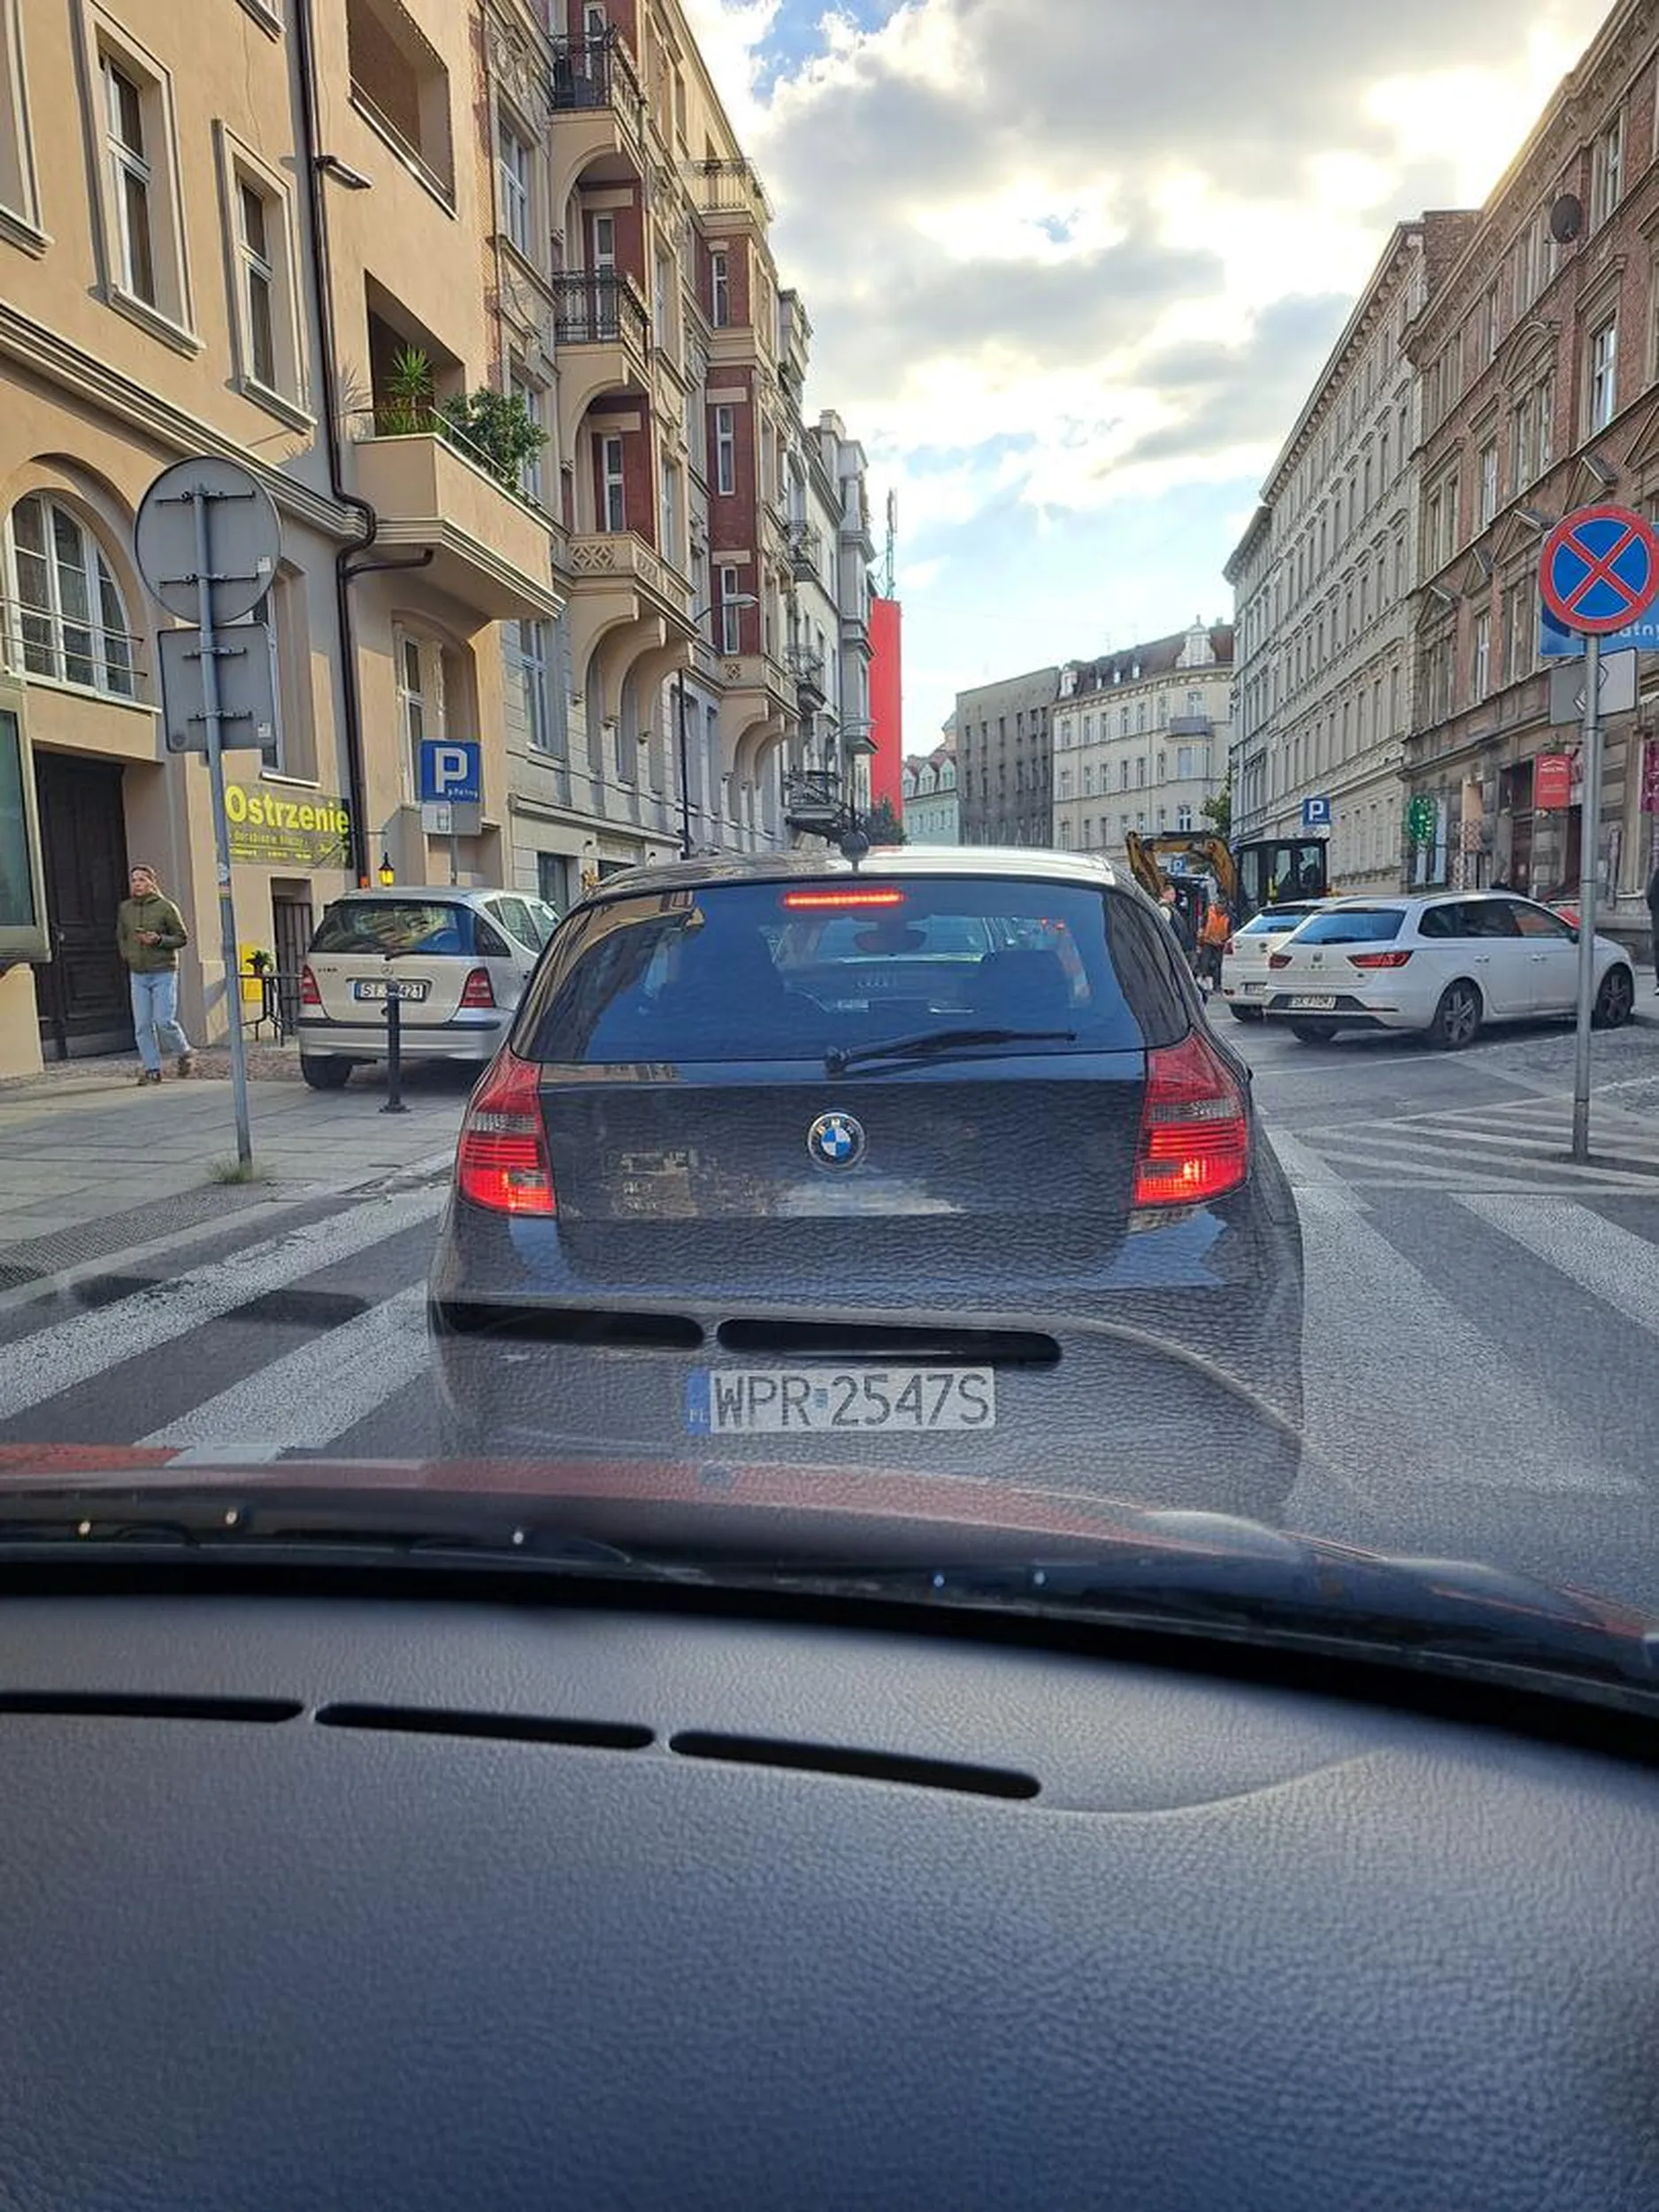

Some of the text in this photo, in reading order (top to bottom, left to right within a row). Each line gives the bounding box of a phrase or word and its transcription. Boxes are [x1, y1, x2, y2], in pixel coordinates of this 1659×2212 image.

[434, 747, 467, 793] P
[225, 785, 349, 834] Ostrzenie
[1309, 800, 1325, 820] P
[714, 1373, 990, 1427] WPR 2547S
